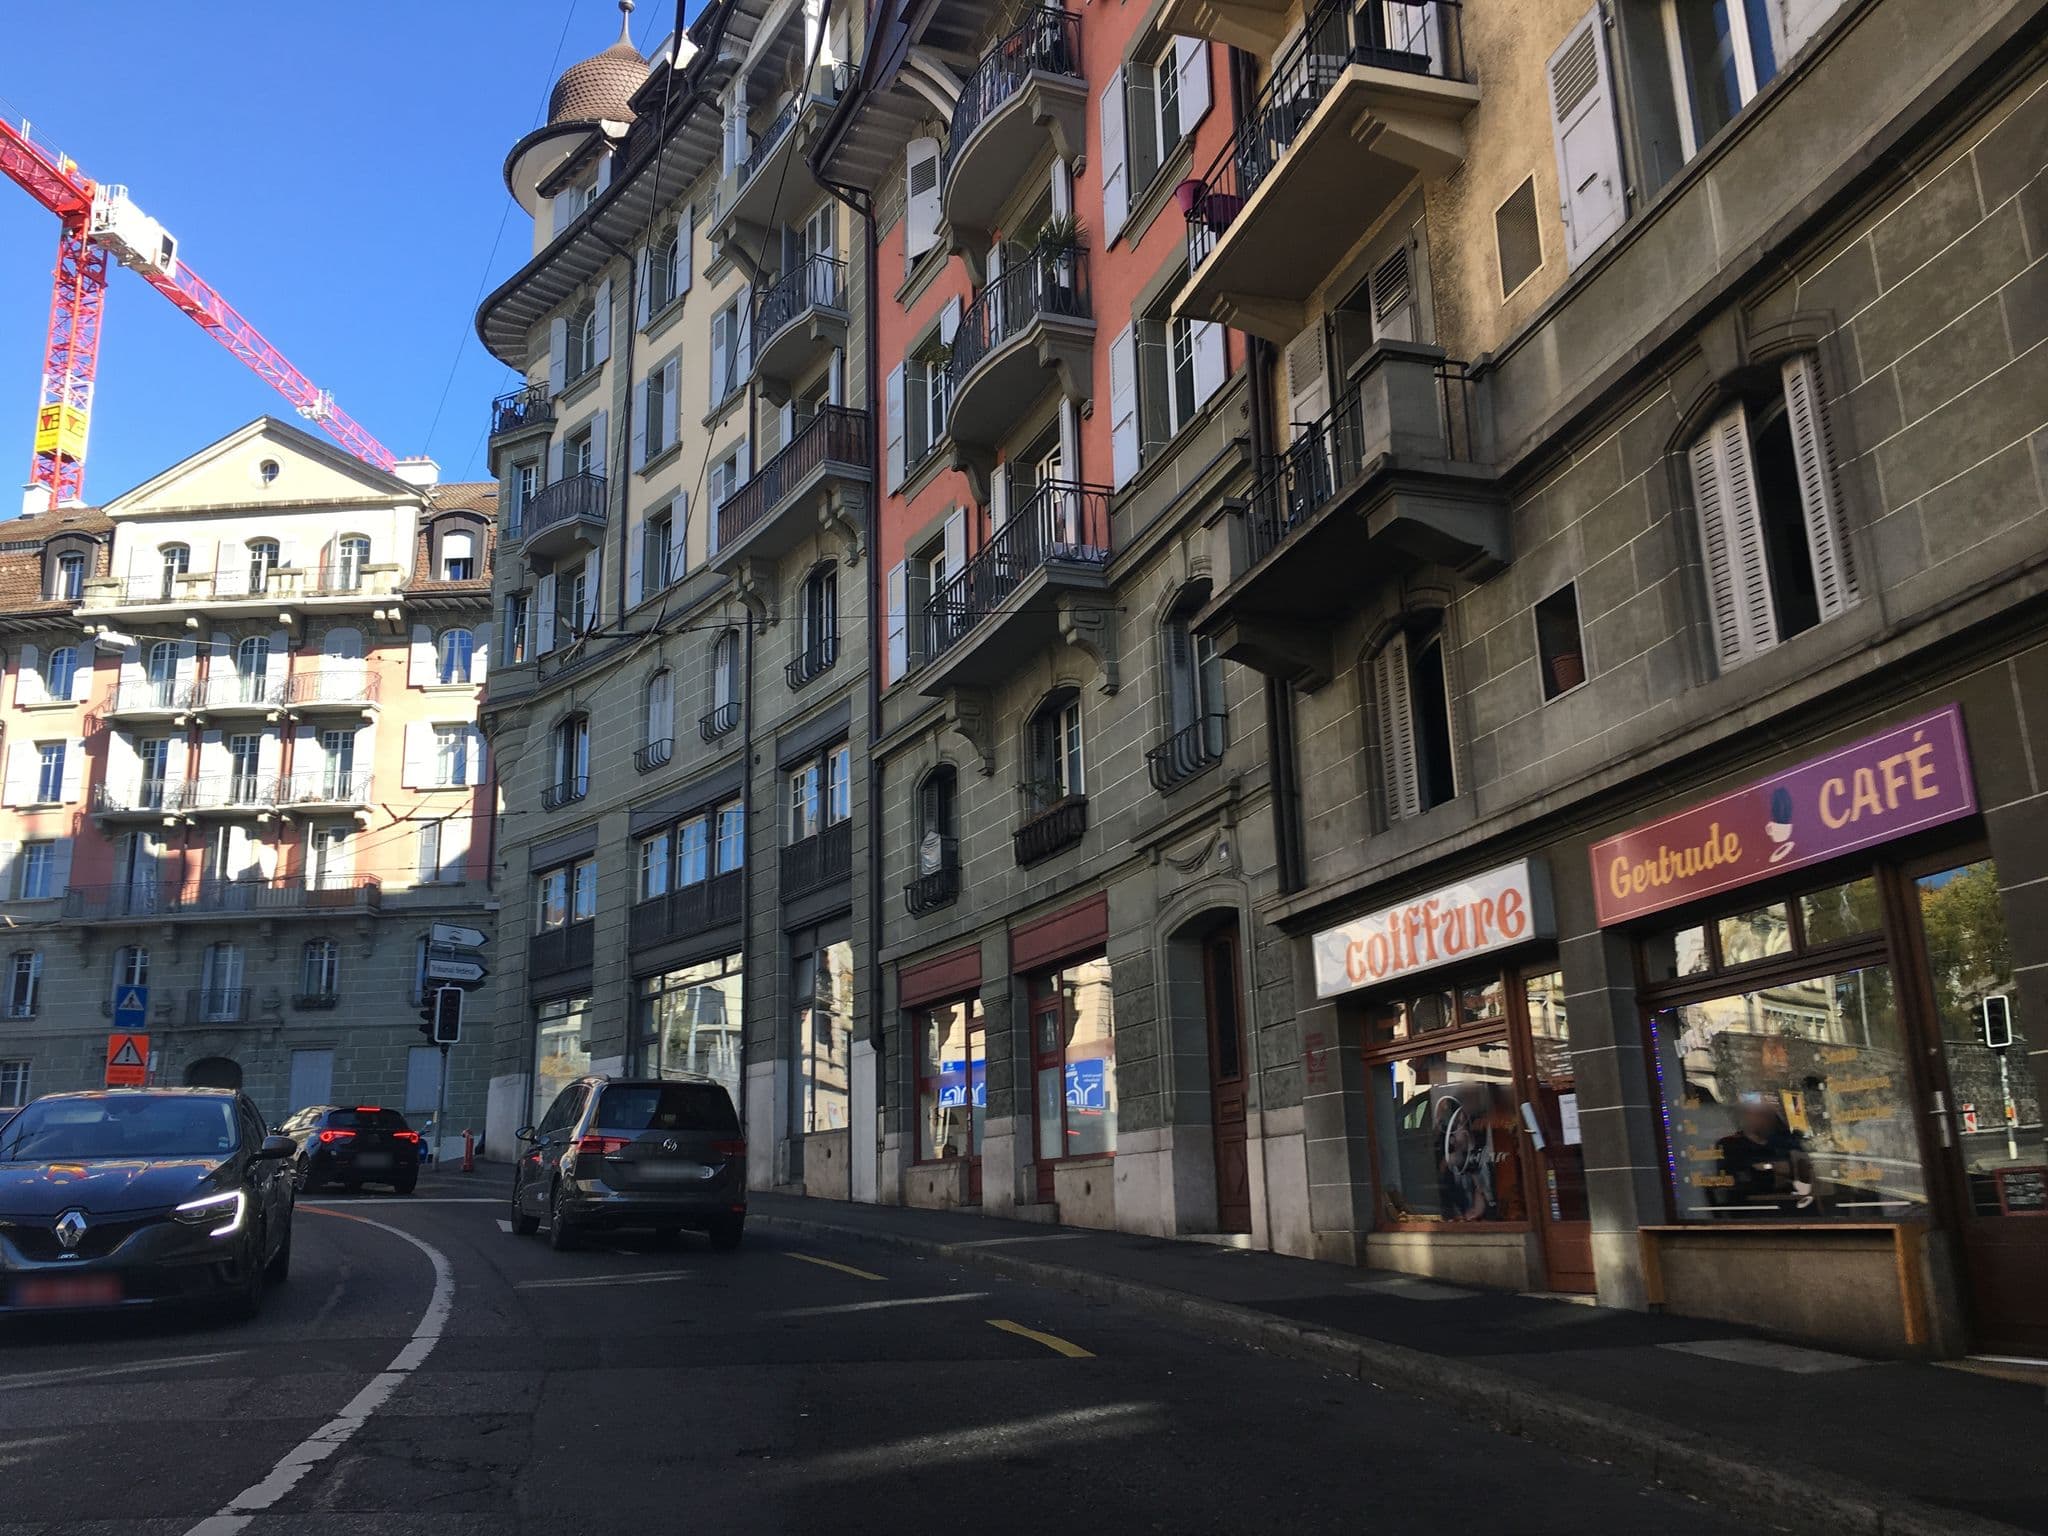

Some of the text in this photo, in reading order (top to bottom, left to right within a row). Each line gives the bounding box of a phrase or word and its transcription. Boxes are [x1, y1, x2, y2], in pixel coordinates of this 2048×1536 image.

[1609, 730, 1940, 899] Gertrude CAFÉ
[1345, 887, 1527, 982] coiffure
